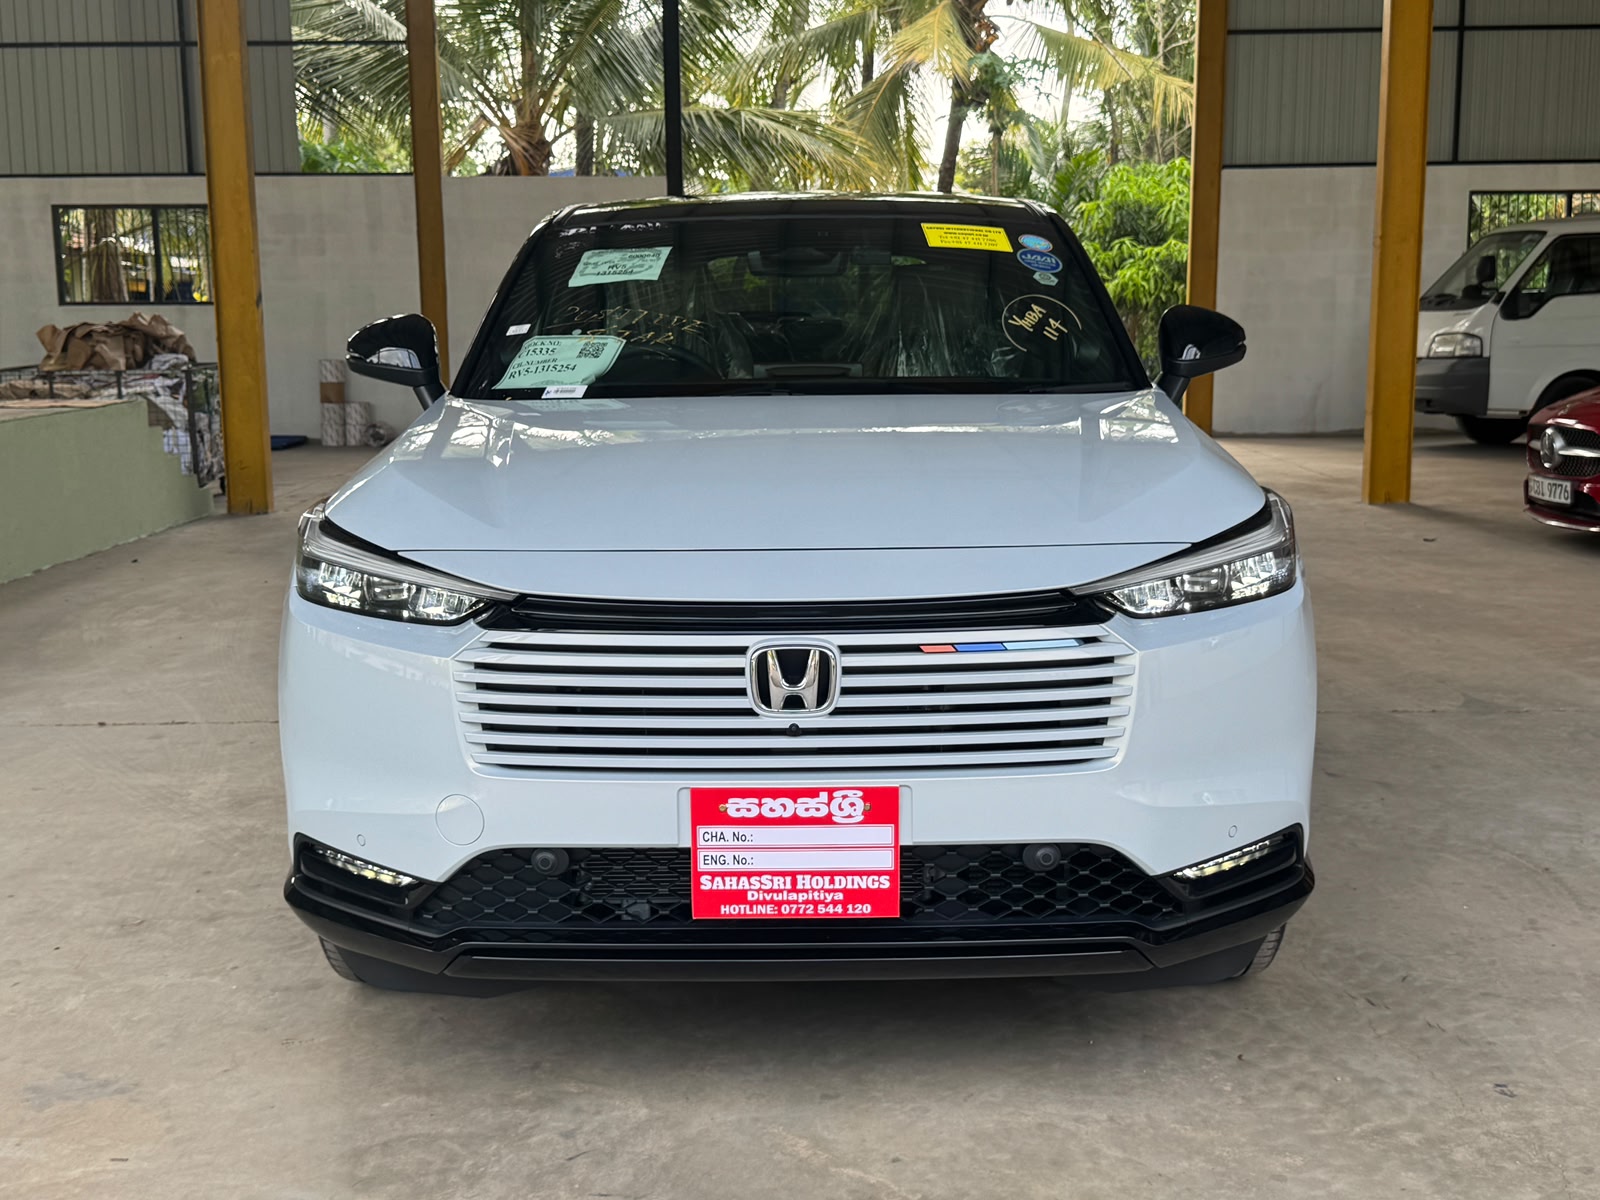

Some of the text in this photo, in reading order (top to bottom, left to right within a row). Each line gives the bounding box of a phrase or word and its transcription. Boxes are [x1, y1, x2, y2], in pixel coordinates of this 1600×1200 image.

[508, 363, 577, 380] RV5-1315254
[1547, 482, 1569, 501] 9776
[702, 831, 754, 843] CHA. No.:
[703, 854, 754, 866] ENG. No.:
[796, 874, 891, 889] HOLDINGS
[747, 890, 844, 902] Divulapitiya
[720, 903, 871, 915] HOTLINE: 0772 544 120
